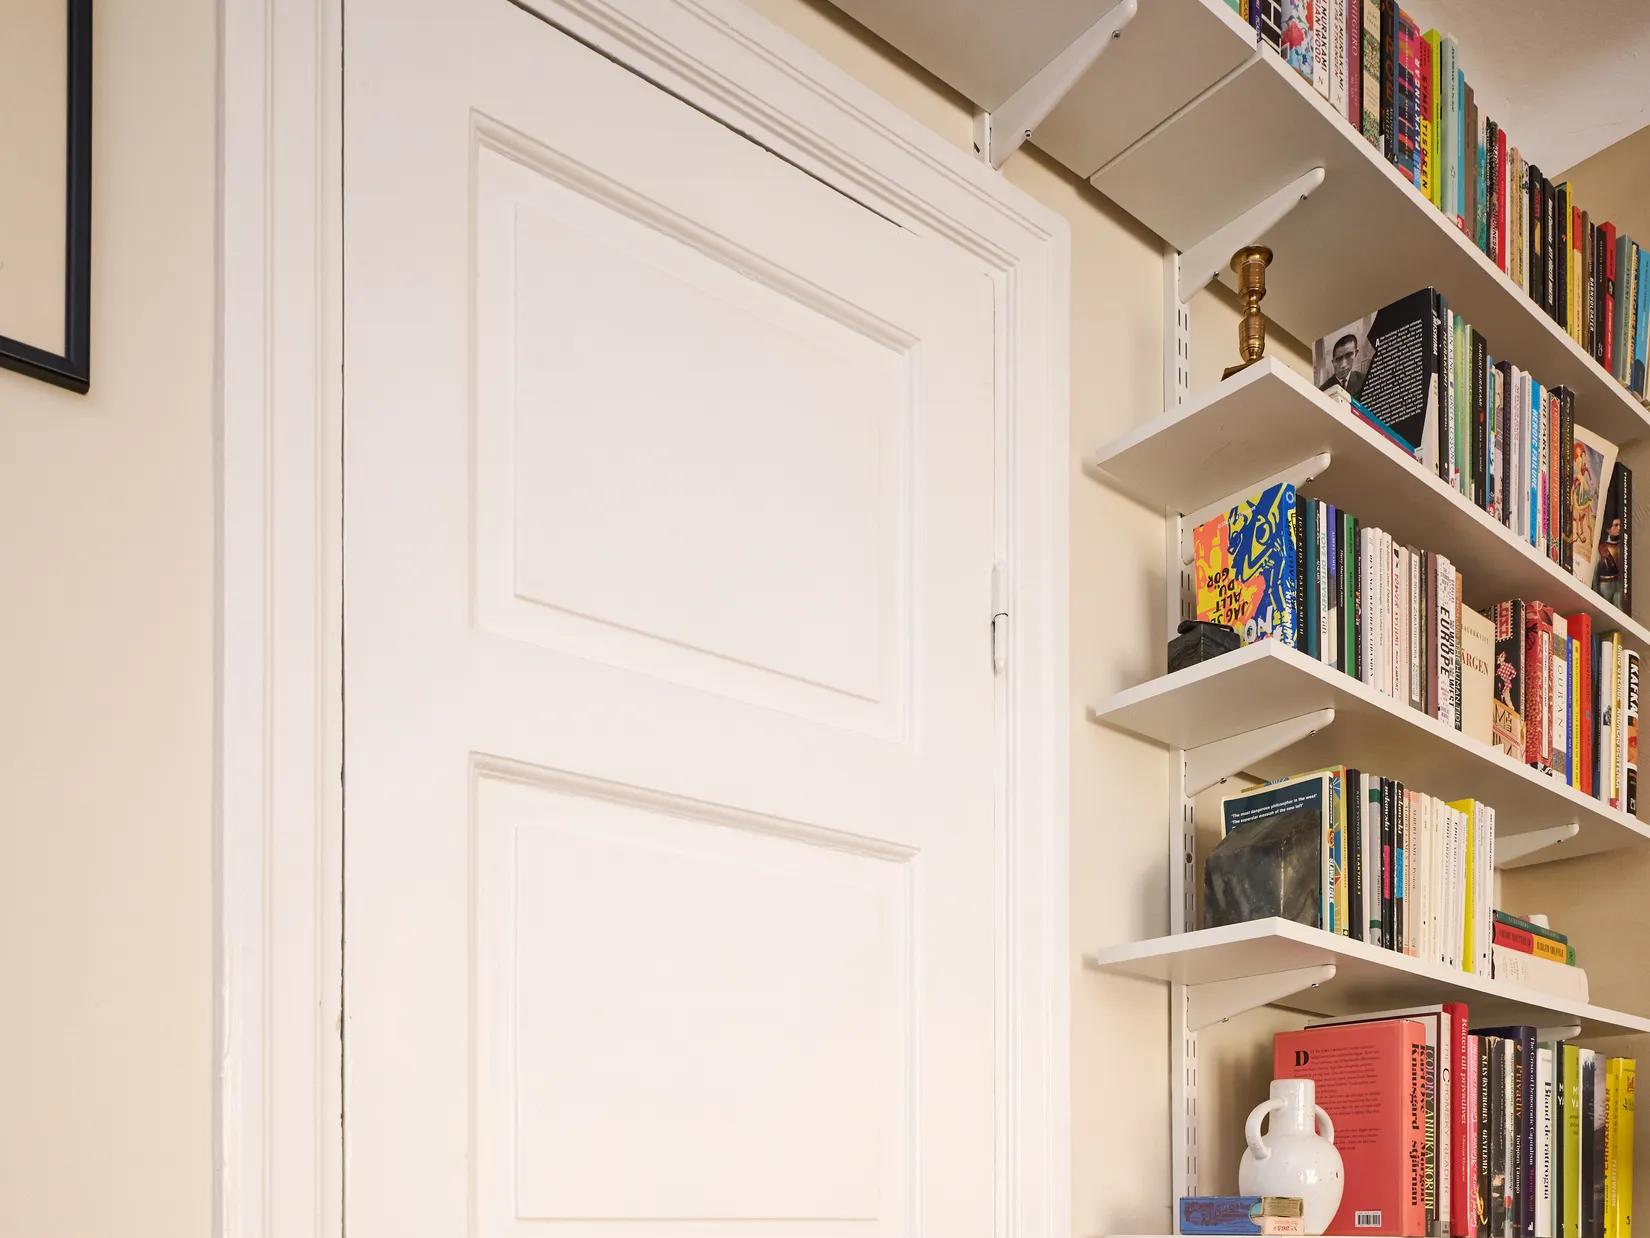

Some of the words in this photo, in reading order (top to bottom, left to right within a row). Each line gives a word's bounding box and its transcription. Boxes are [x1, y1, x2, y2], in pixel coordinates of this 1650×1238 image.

[1207, 568, 1230, 588] GÖR
[1214, 588, 1242, 614] ALLT
[1218, 579, 1235, 598] DU
[1226, 601, 1248, 622] JAG
[1441, 606, 1450, 679] EUROPE
[1630, 664, 1639, 714] KAFKA
[1295, 1050, 1309, 1066] D
[1426, 1050, 1434, 1104] COLONY
[1410, 1042, 1420, 1130] Knausgård
[1426, 1108, 1434, 1158] ANNIKA
[1544, 1124, 1552, 1140] de
[1410, 1140, 1420, 1206] stjärnan
[1426, 1164, 1434, 1209] NORLIN
[1544, 1143, 1552, 1200] rättrogna
